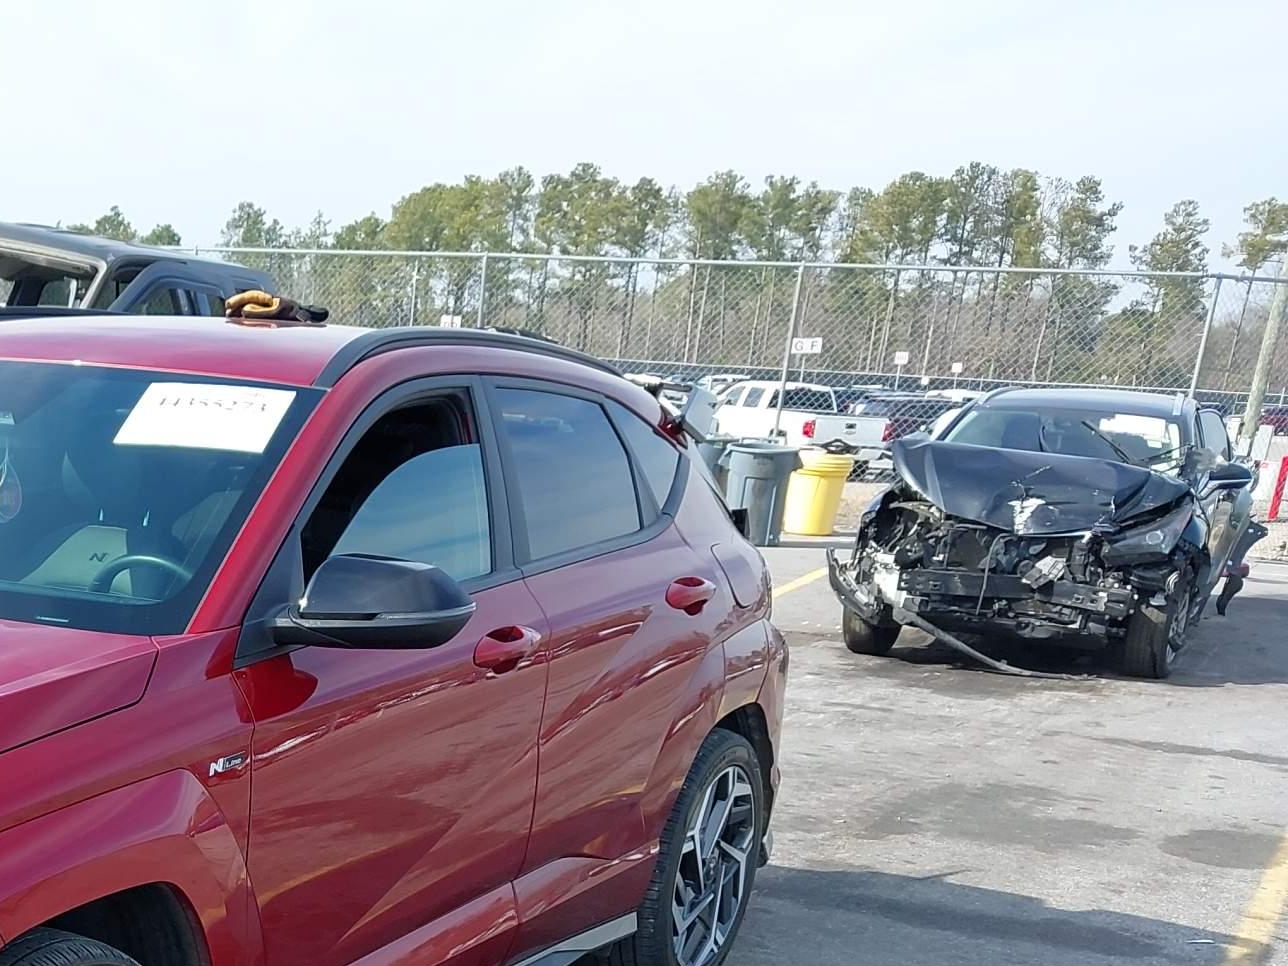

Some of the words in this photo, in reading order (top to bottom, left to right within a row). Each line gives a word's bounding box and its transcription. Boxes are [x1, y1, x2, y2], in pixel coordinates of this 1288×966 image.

[794, 340, 804, 352] G
[810, 340, 818, 351] F
[208, 757, 225, 777] N
